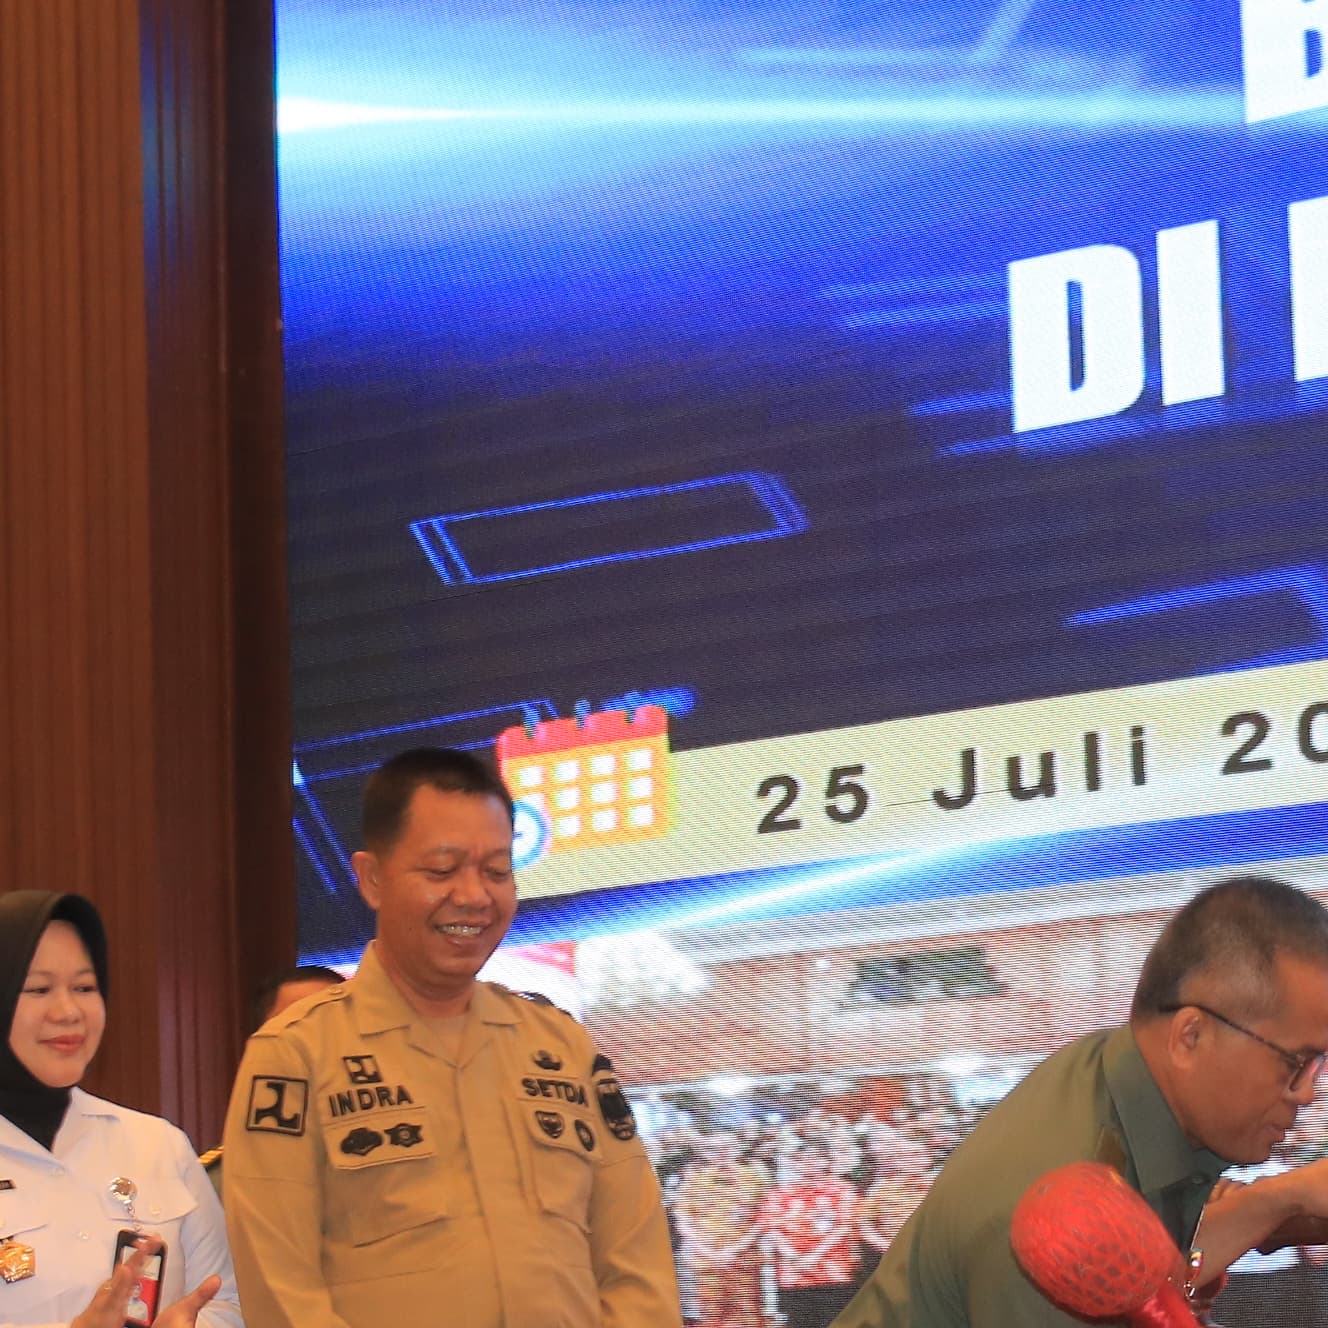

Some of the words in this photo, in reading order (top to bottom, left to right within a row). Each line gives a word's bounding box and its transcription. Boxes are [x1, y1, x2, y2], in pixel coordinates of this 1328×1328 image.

[1006, 220, 1225, 434] DI
[755, 763, 870, 835] 25
[931, 725, 1149, 812] Juli
[328, 1084, 414, 1118] INDRA
